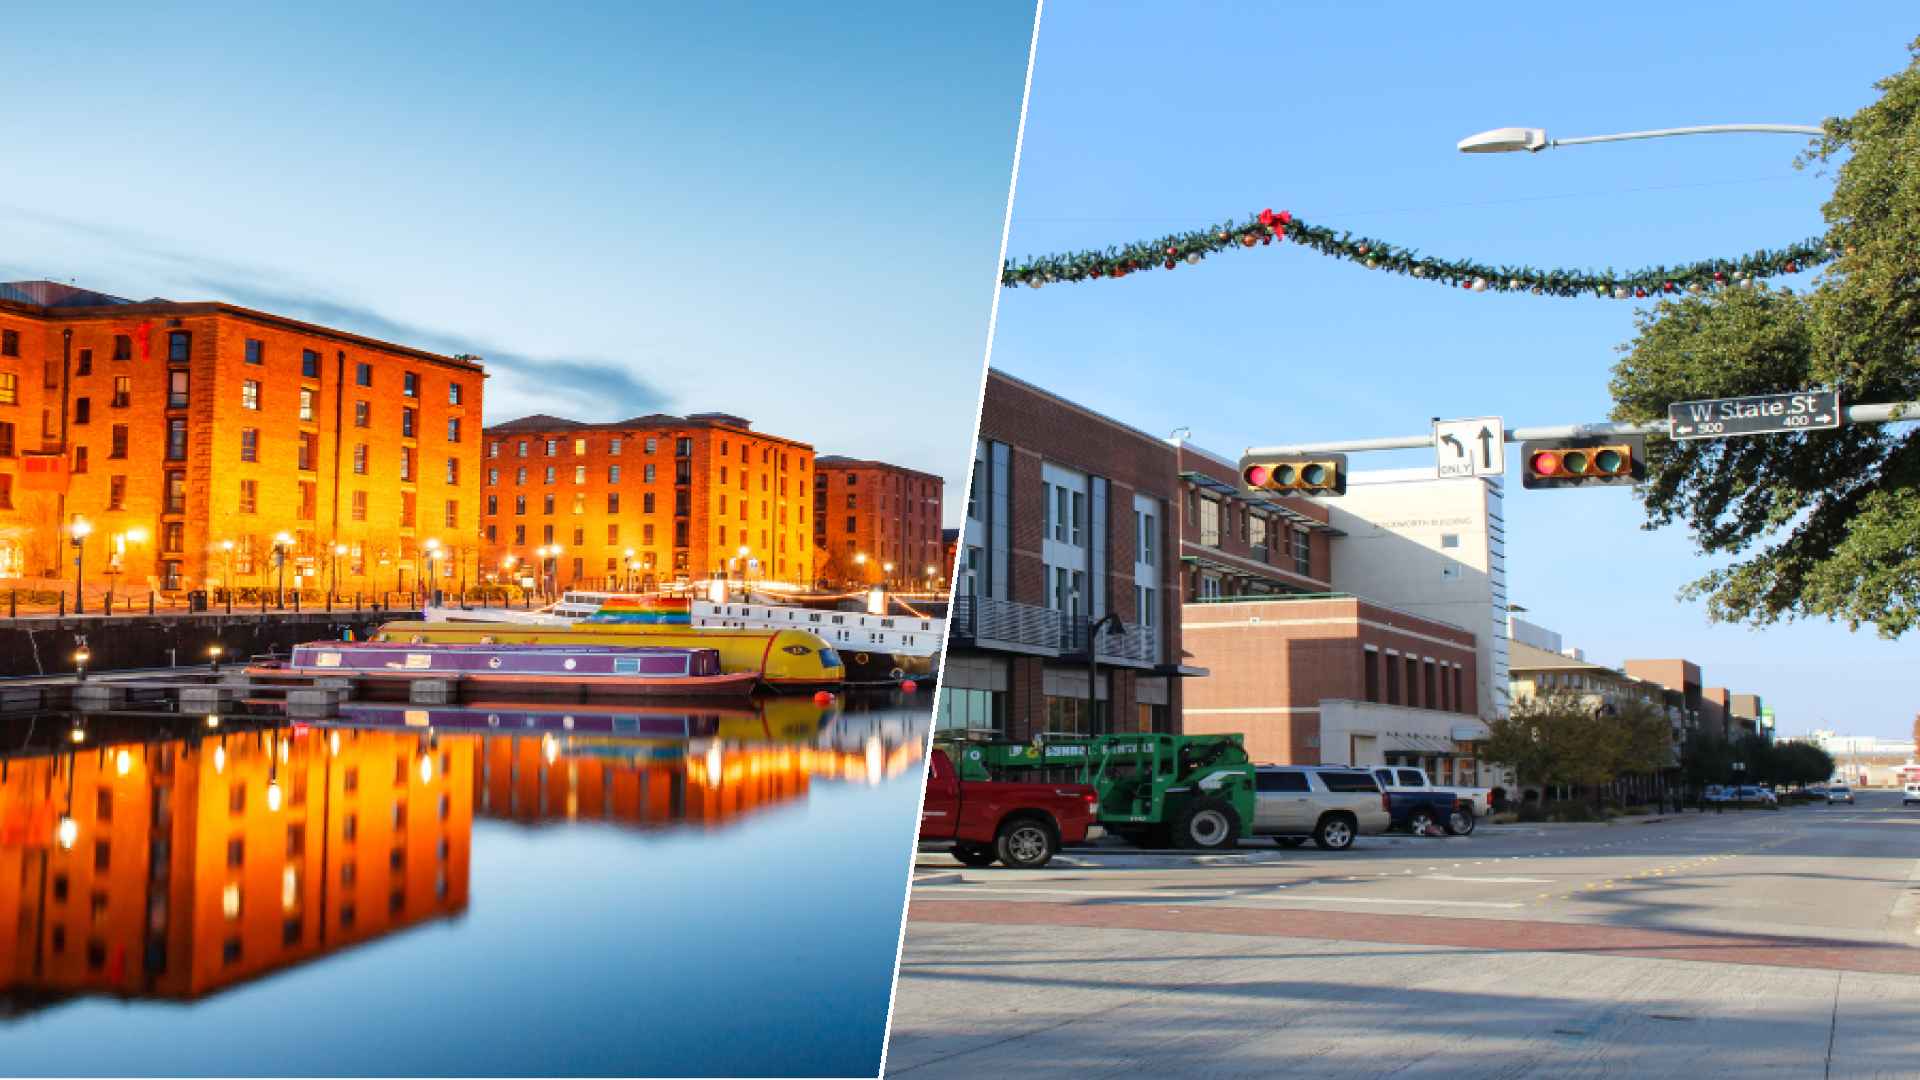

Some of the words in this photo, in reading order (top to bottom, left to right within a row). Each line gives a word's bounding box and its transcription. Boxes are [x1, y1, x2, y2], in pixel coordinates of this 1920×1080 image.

[1689, 403, 1713, 422] W
[1720, 399, 1785, 420] State
[1792, 395, 1817, 414] St
[1783, 415, 1809, 426] 400
[1698, 422, 1724, 433] 500
[1440, 464, 1471, 475] ONLY
